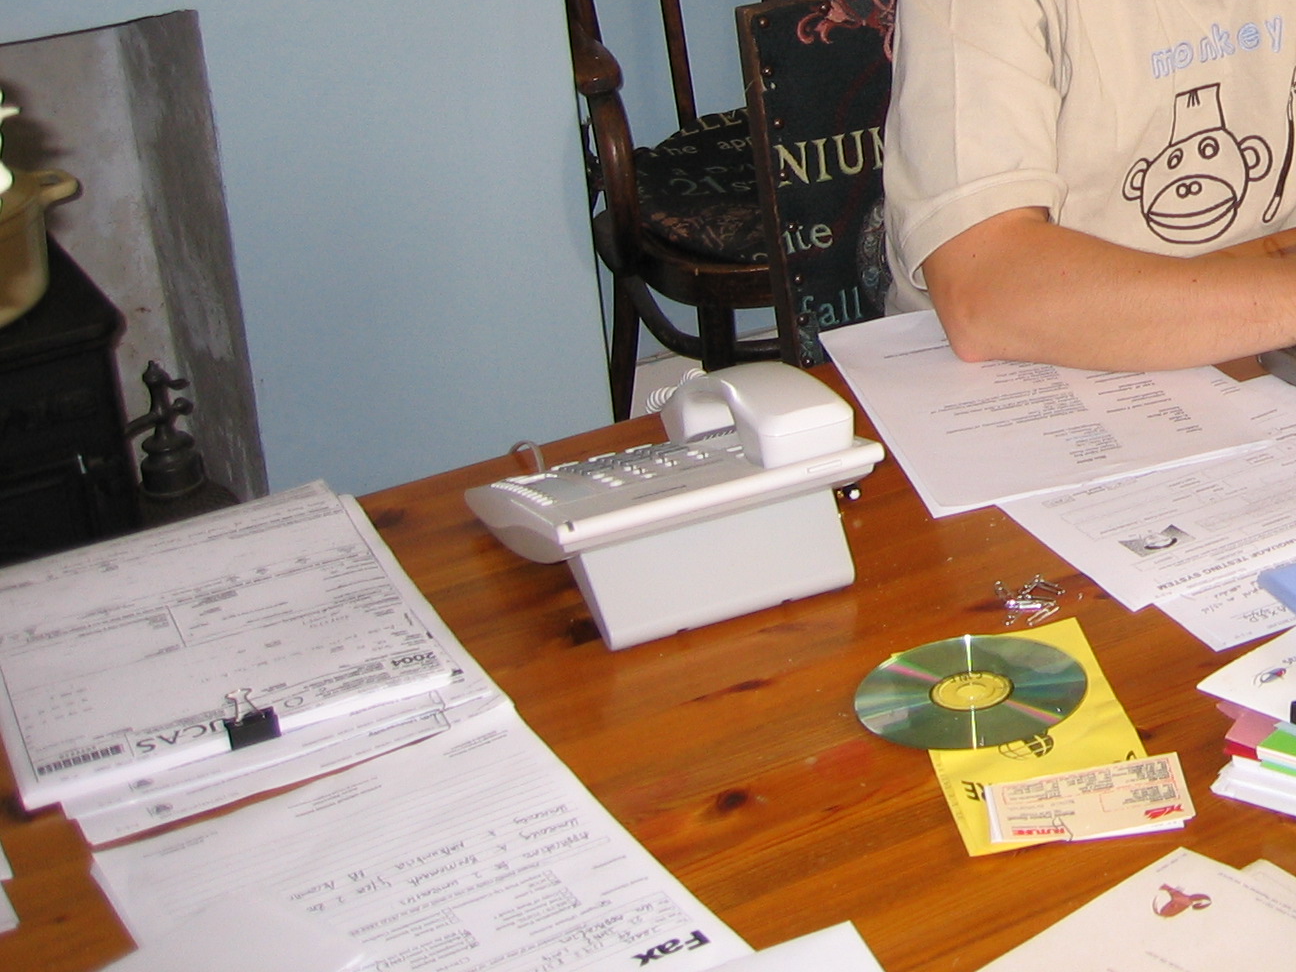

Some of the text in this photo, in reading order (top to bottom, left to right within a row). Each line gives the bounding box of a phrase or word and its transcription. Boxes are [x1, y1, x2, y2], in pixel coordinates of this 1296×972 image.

[1151, 15, 1283, 79] monkey
[800, 286, 865, 328] fall
[391, 651, 436, 667] 2004
[630, 929, 711, 968] Fax
